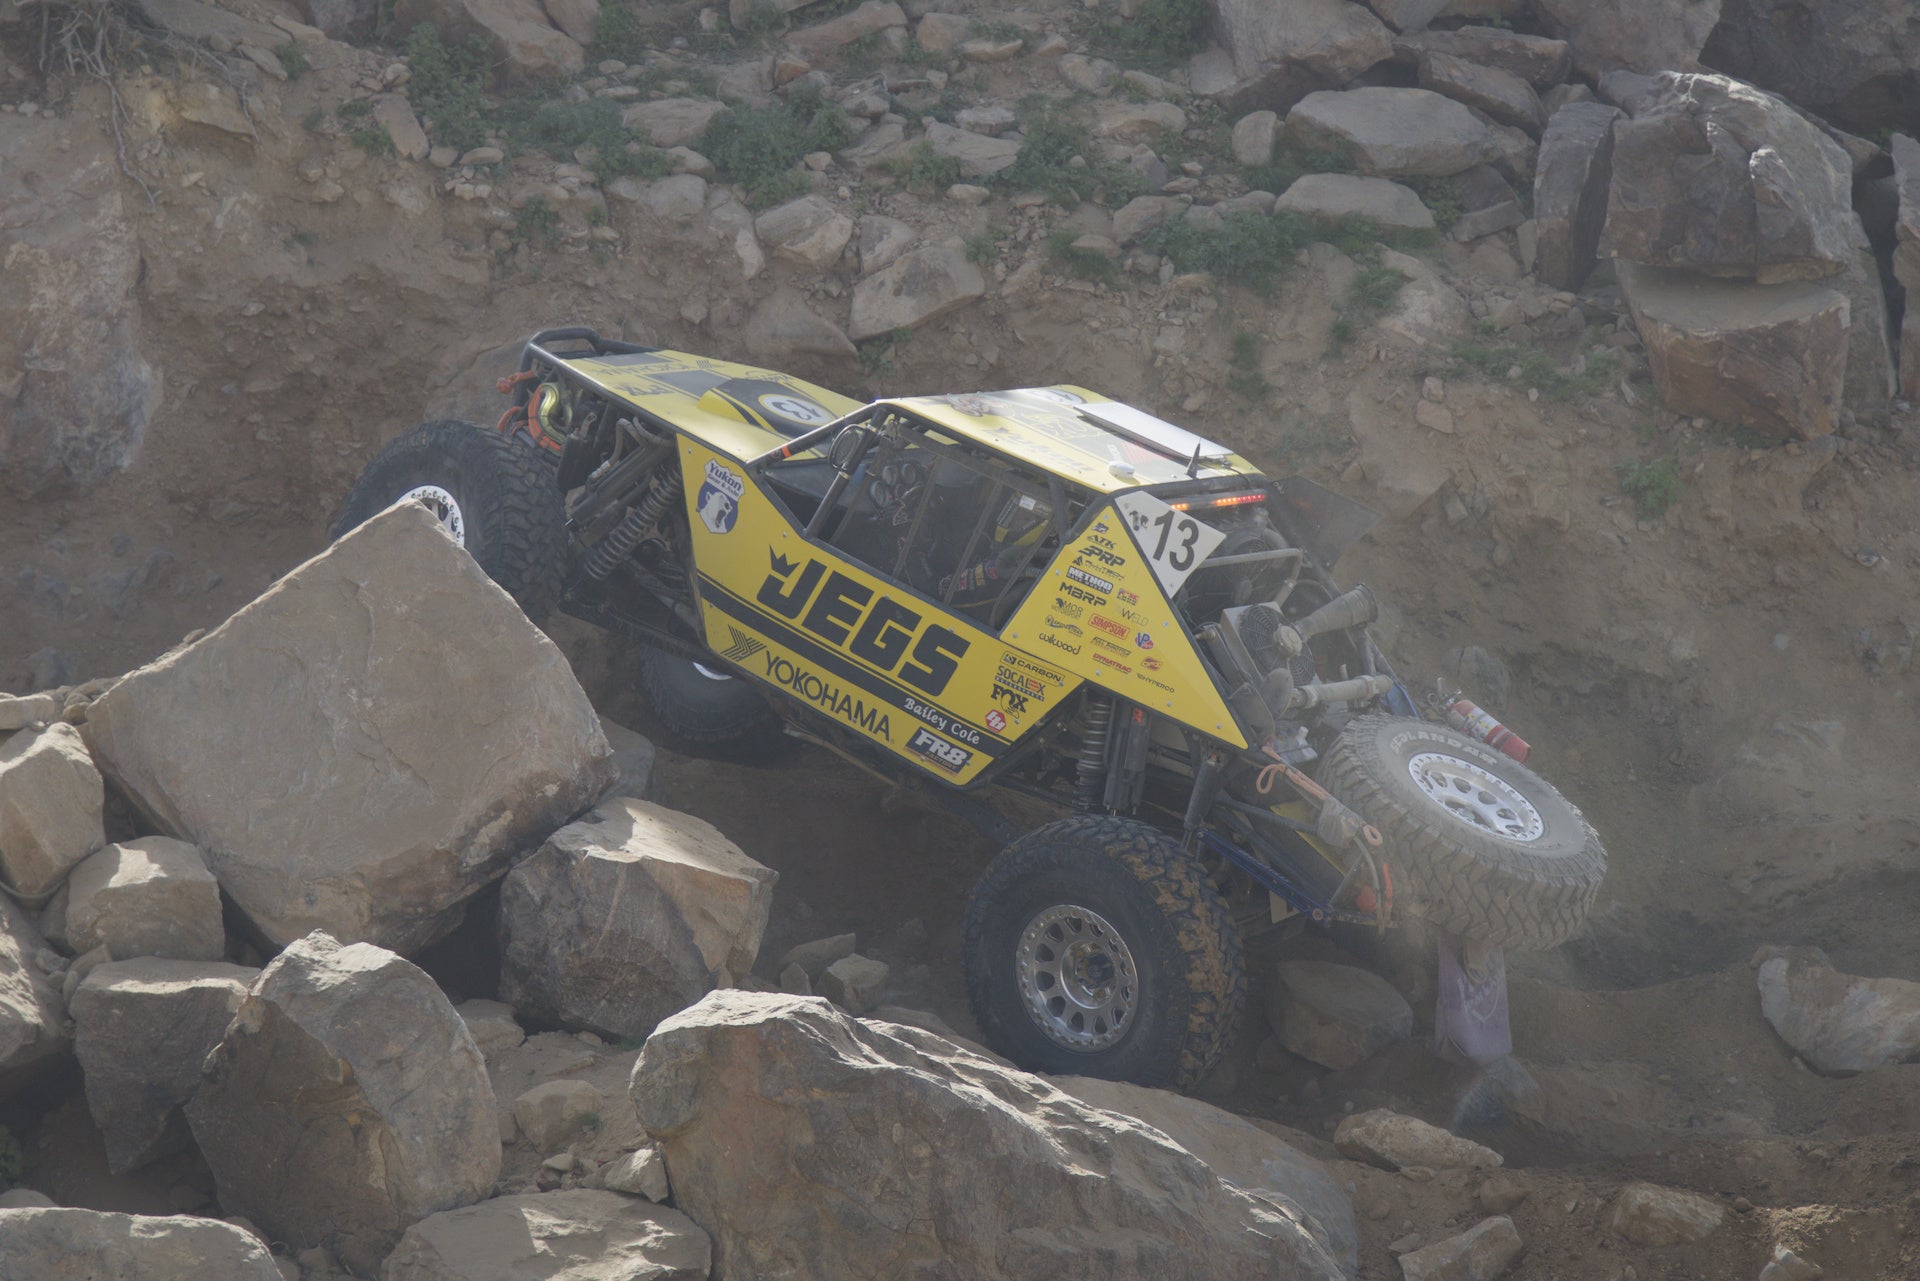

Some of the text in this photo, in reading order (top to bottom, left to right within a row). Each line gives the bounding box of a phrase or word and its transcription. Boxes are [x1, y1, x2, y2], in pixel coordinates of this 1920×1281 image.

[709, 462, 742, 492] Yukon
[1152, 510, 1199, 572] 13
[1069, 567, 1113, 591] METHOD
[1059, 582, 1107, 608] MBRP
[756, 557, 972, 698] JEGS
[1091, 616, 1127, 638] SIMPSON
[1121, 607, 1149, 627] WELD
[1017, 659, 1062, 682] CARBON
[1093, 652, 1132, 674] DYNATRAC
[764, 650, 891, 742] YOKOHAMA
[990, 683, 1030, 713] FOX
[1141, 675, 1175, 693] HYPERCO
[903, 697, 981, 745] Bailey Cole
[915, 729, 968, 766] FR8
